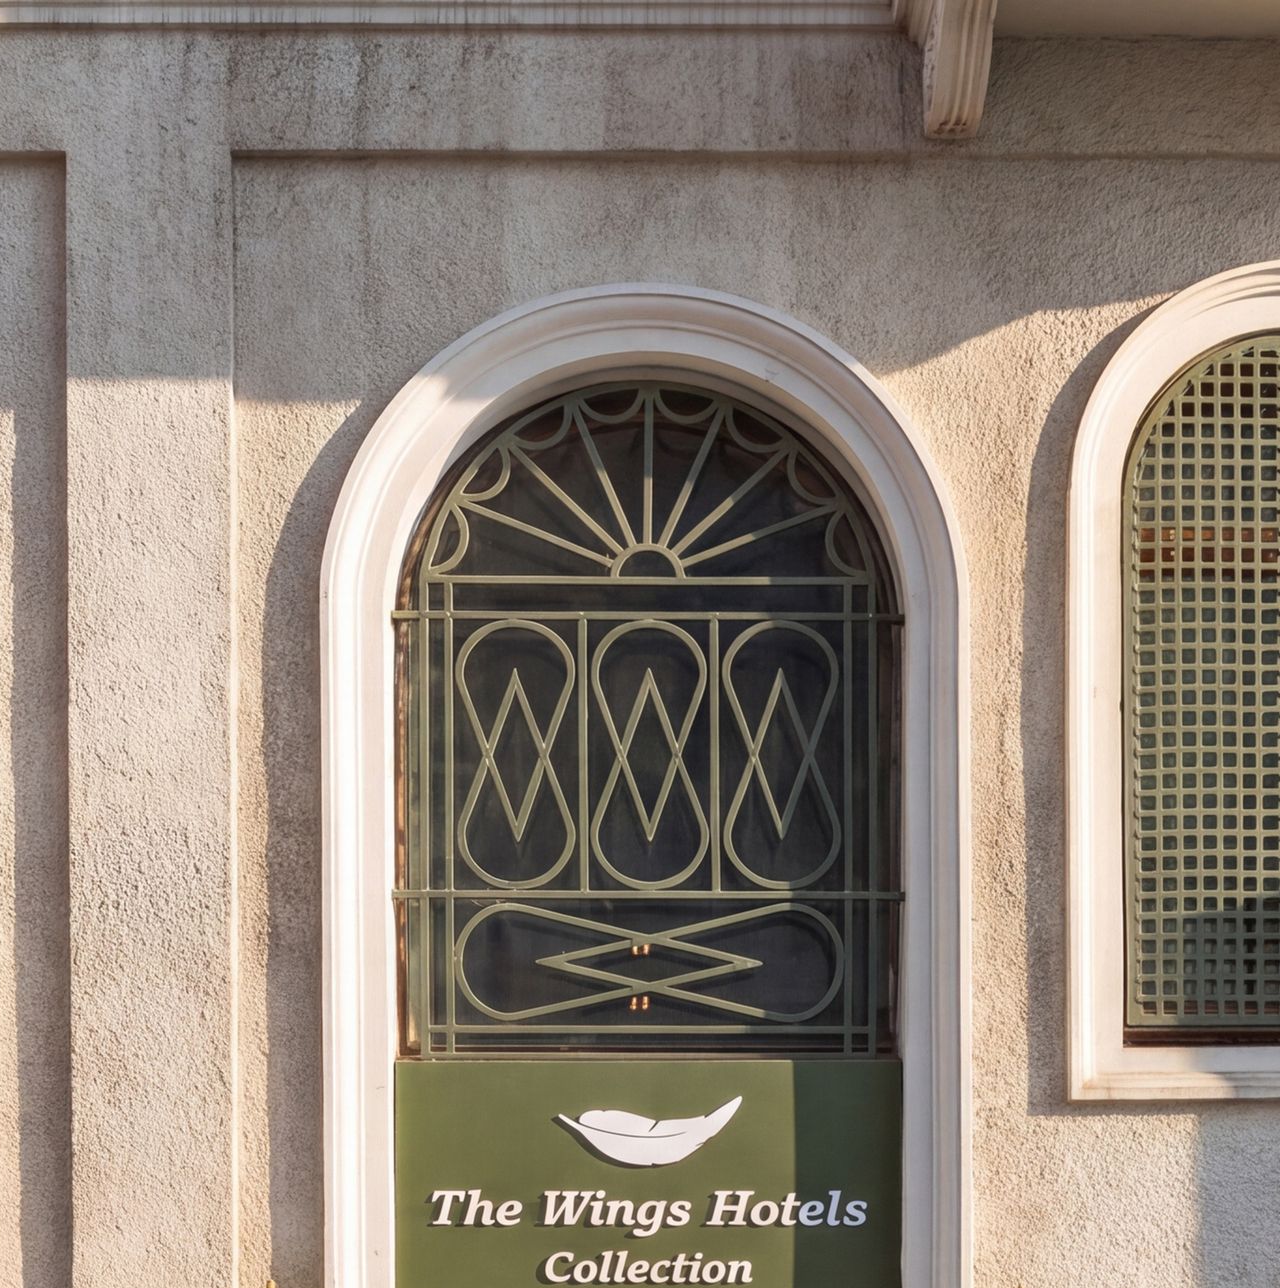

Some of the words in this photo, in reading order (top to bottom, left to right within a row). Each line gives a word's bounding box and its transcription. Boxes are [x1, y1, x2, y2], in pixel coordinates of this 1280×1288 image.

[429, 1189, 523, 1227] The
[542, 1189, 693, 1238] Wings
[705, 1189, 869, 1227] Hotels
[543, 1250, 754, 1285] Collection
